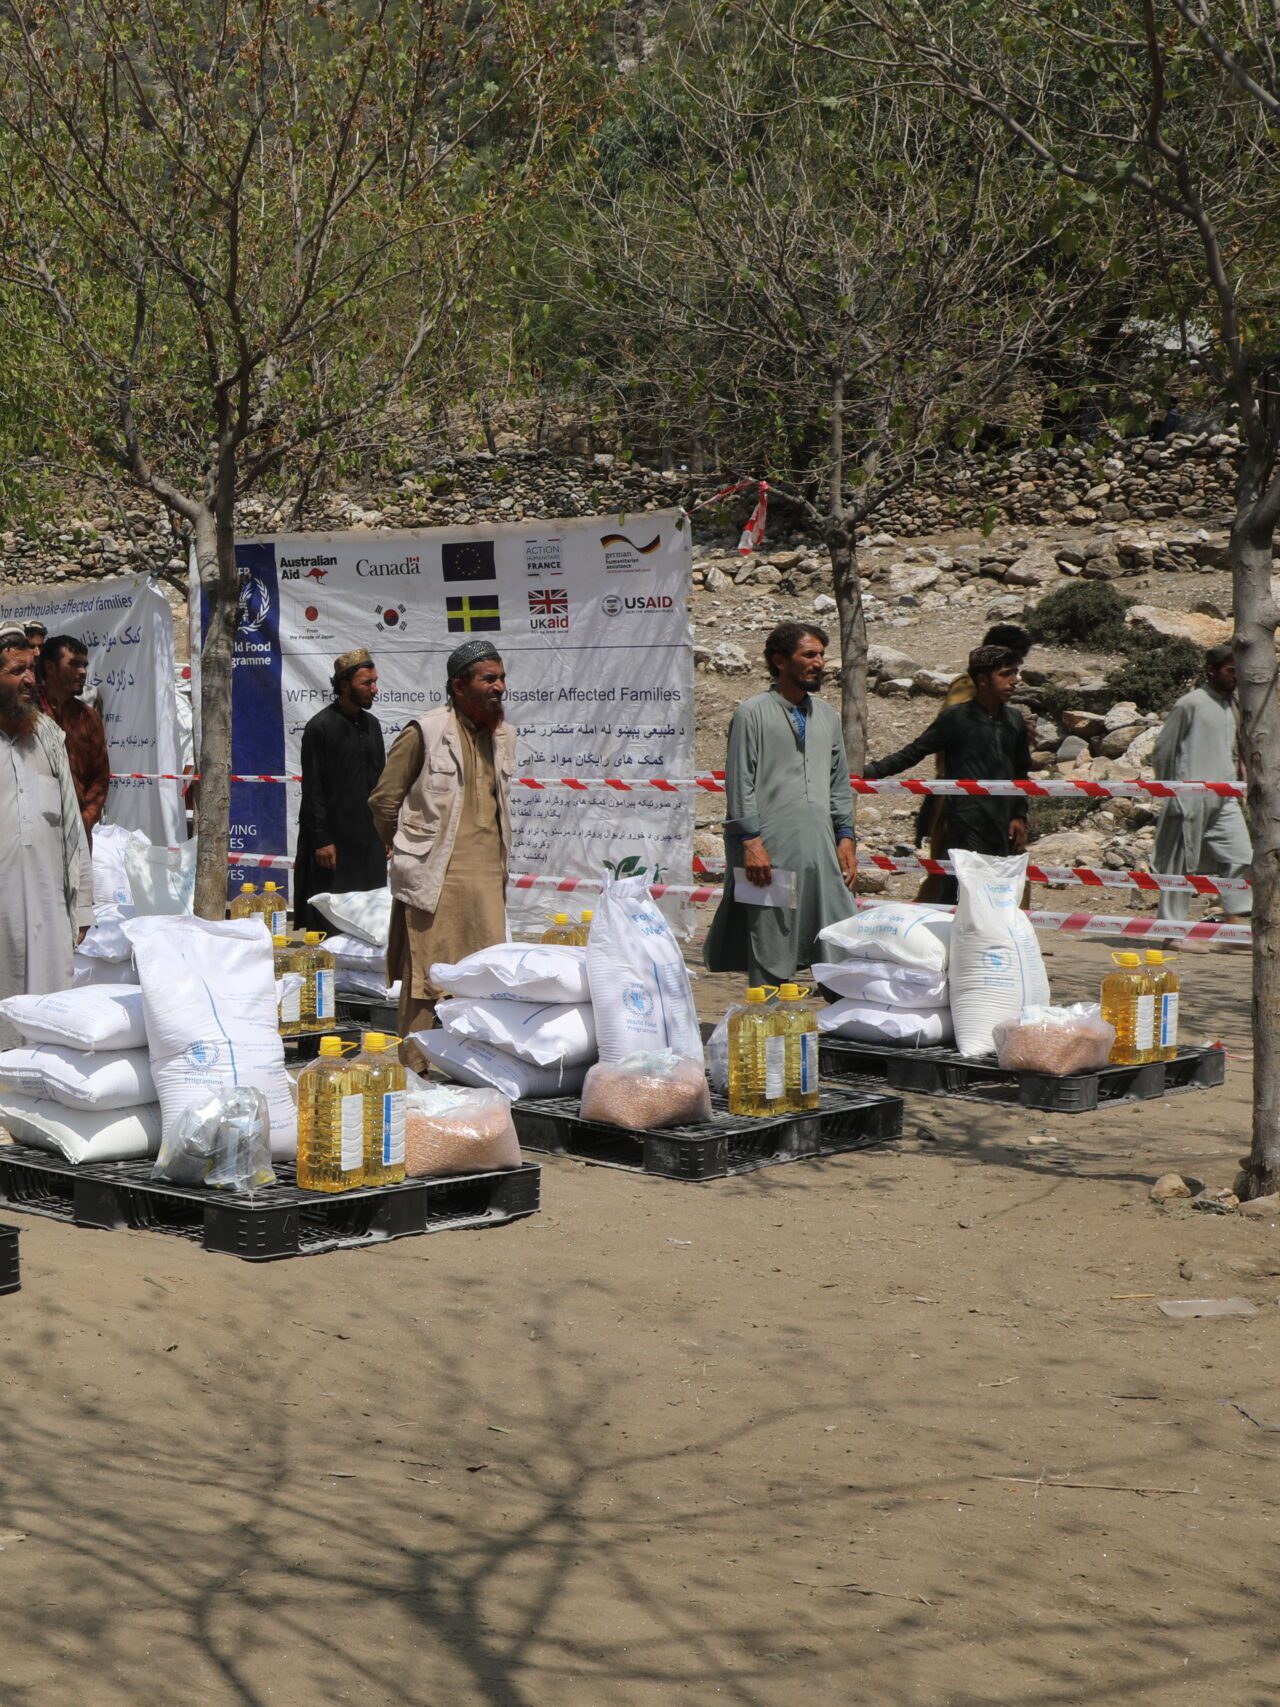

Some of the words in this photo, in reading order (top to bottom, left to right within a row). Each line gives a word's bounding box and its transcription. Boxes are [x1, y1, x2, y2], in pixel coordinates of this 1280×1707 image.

[526, 545, 560, 554] ACTION
[280, 555, 337, 568] Australian
[356, 557, 420, 577] Canada
[527, 561, 561, 570] FRANCE
[281, 569, 300, 580] Aid
[1, 604, 12, 618] for
[14, 596, 94, 619] earthquake-affected
[95, 594, 133, 611] families
[625, 596, 673, 609] USAID
[245, 641, 271, 652] Food
[231, 657, 271, 668] gramme
[286, 689, 318, 702] WFP
[373, 689, 425, 702] sistance
[429, 691, 441, 702] to
[502, 688, 554, 702] Disaster
[557, 687, 615, 702] Affected
[620, 687, 681, 701] Families
[229, 824, 257, 836] VING
